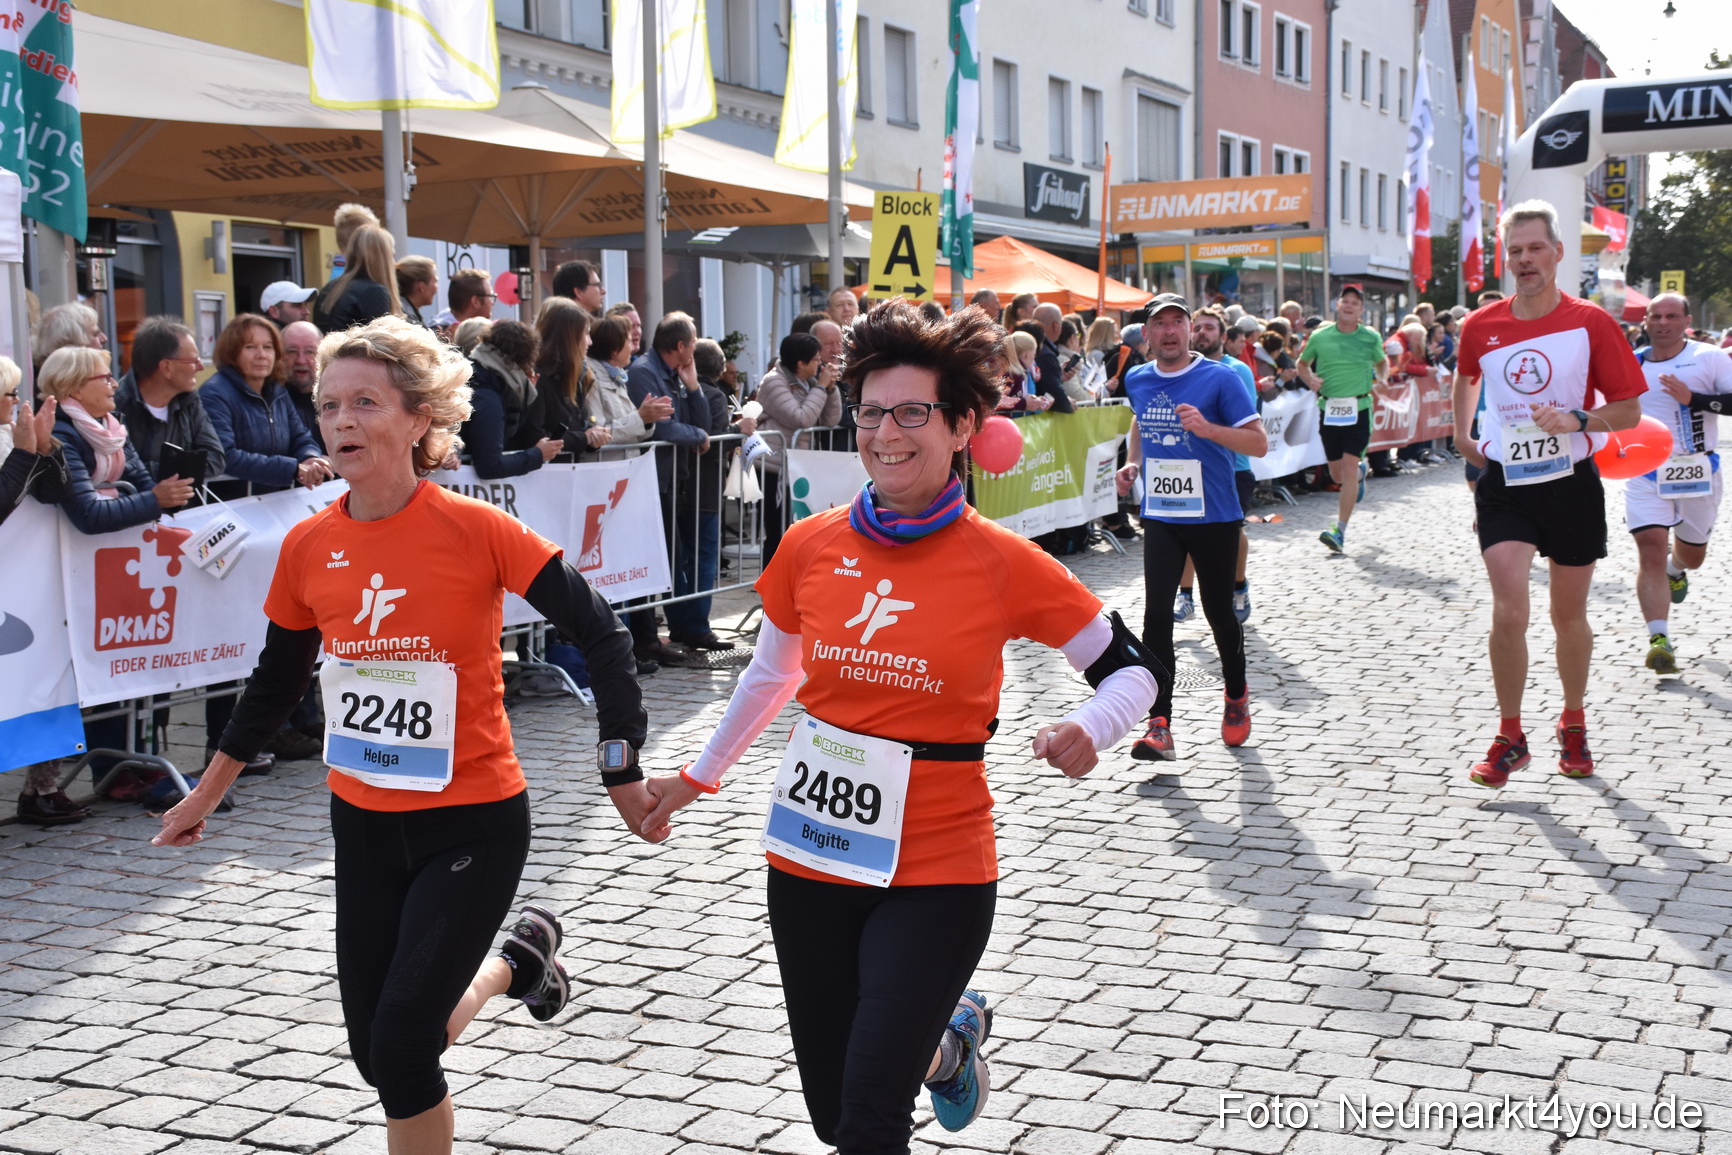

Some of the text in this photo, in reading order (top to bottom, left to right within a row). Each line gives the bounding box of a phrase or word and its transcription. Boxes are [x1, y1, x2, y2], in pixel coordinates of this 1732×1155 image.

[881, 196, 932, 216] Block
[883, 224, 921, 276] A
[1330, 406, 1353, 416] 2758
[1510, 436, 1560, 461] 2173
[1523, 463, 1551, 475] Rüdiger
[1666, 466, 1703, 481] 2238
[1153, 477, 1193, 495] 2604
[327, 560, 350, 569] erima
[834, 567, 862, 578] erima
[595, 571, 627, 588] EINZELNE
[628, 566, 648, 581] ZÄHLT
[99, 611, 171, 647] DKMS
[332, 635, 431, 656] funrunners
[812, 640, 928, 673] funrunners
[110, 643, 246, 678] JEDER EINZELNE ZÄHLT
[370, 668, 416, 683] BOCK
[839, 665, 944, 695] neumarkt
[341, 691, 433, 740] 2248
[364, 747, 399, 768] Helga
[821, 737, 865, 762] BOCK
[788, 760, 881, 825] 2489
[802, 823, 850, 852] Brigitte
